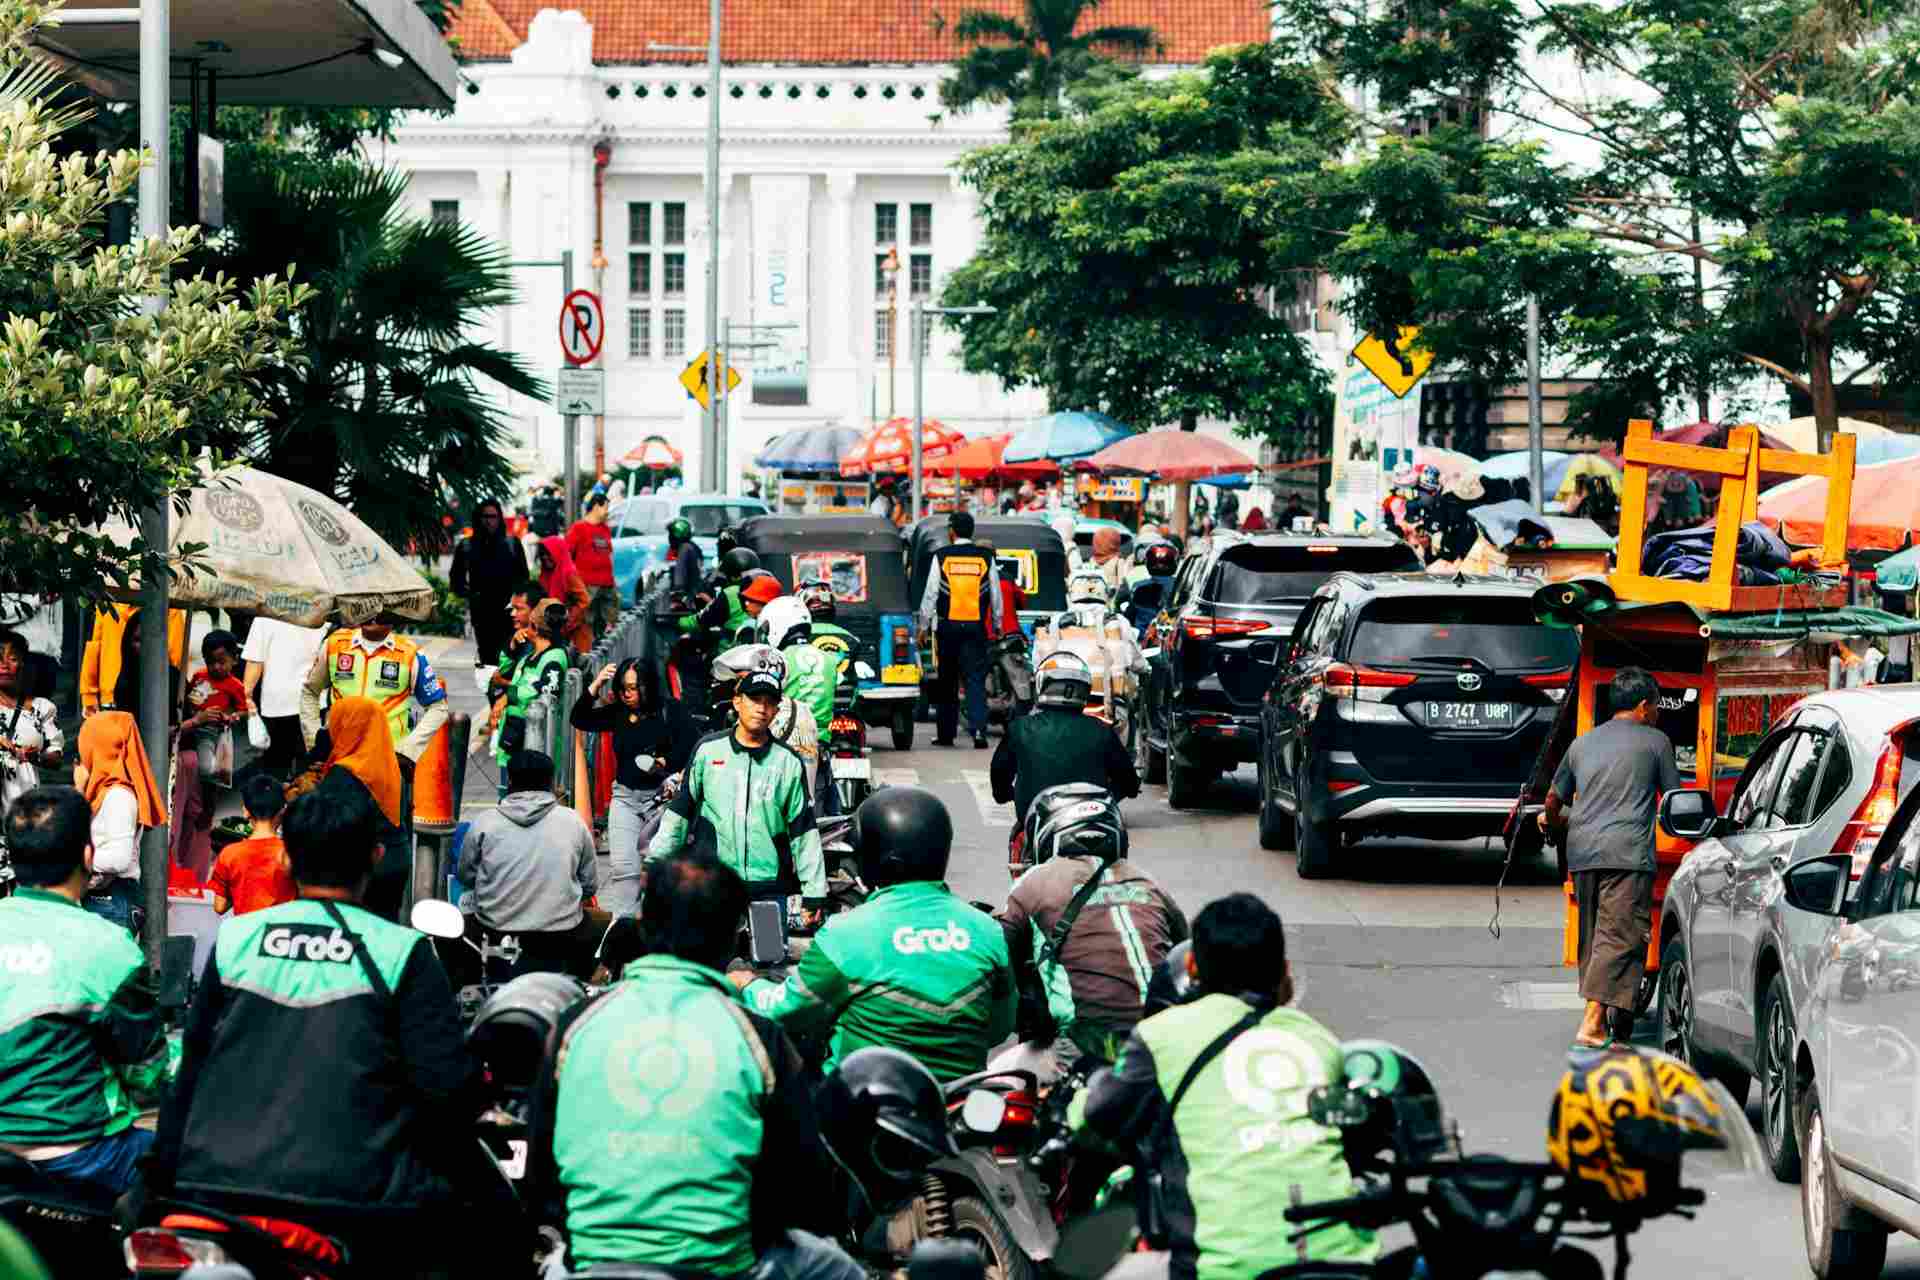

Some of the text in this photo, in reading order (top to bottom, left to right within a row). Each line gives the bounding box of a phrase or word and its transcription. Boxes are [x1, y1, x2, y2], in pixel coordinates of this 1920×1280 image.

[1431, 703, 1439, 718] B
[1445, 703, 1475, 718] 2747
[263, 928, 353, 962] Grab
[893, 920, 971, 954] Grab
[0, 939, 51, 974] rab
